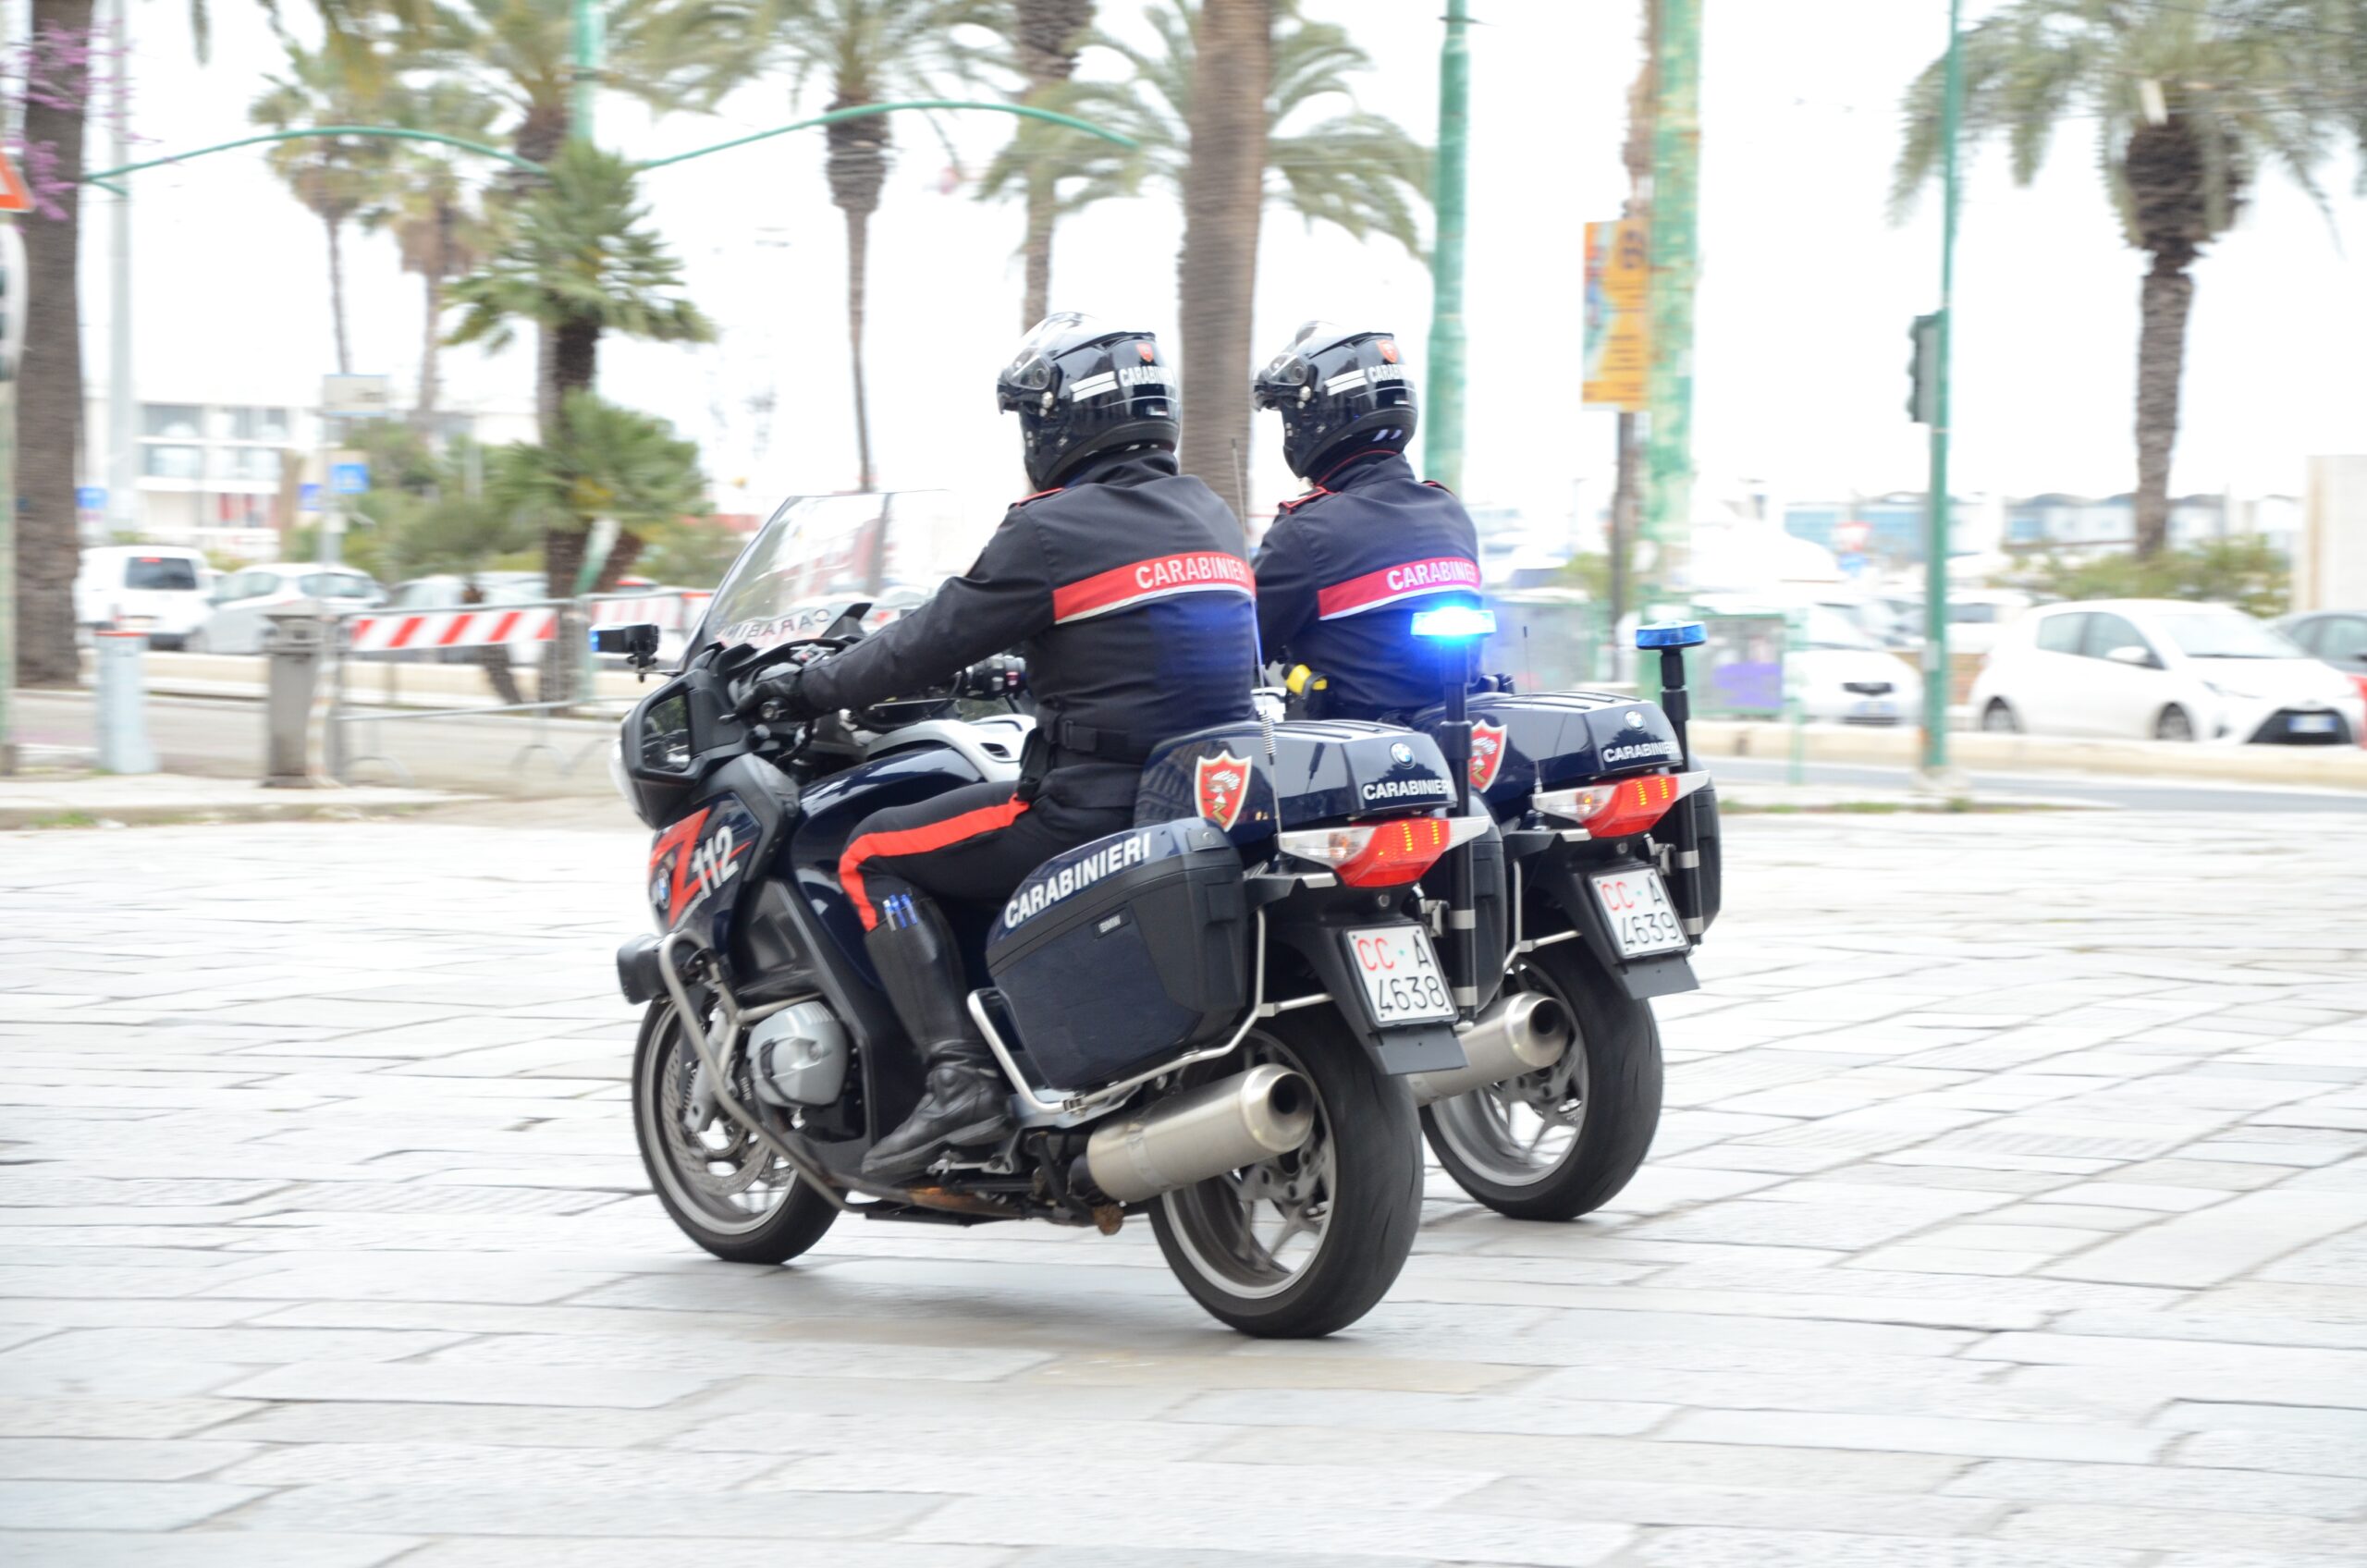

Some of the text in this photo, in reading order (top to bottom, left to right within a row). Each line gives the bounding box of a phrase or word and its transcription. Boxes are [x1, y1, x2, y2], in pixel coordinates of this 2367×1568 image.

[1134, 557, 1248, 589] CARABINIER
[692, 826, 740, 899] 112
[1004, 832, 1151, 929] CARABINIERI
[1601, 876, 1664, 911] CC A
[1622, 912, 1679, 945] 4639
[1356, 934, 1432, 972] CC A
[1378, 975, 1445, 1012] 4638
